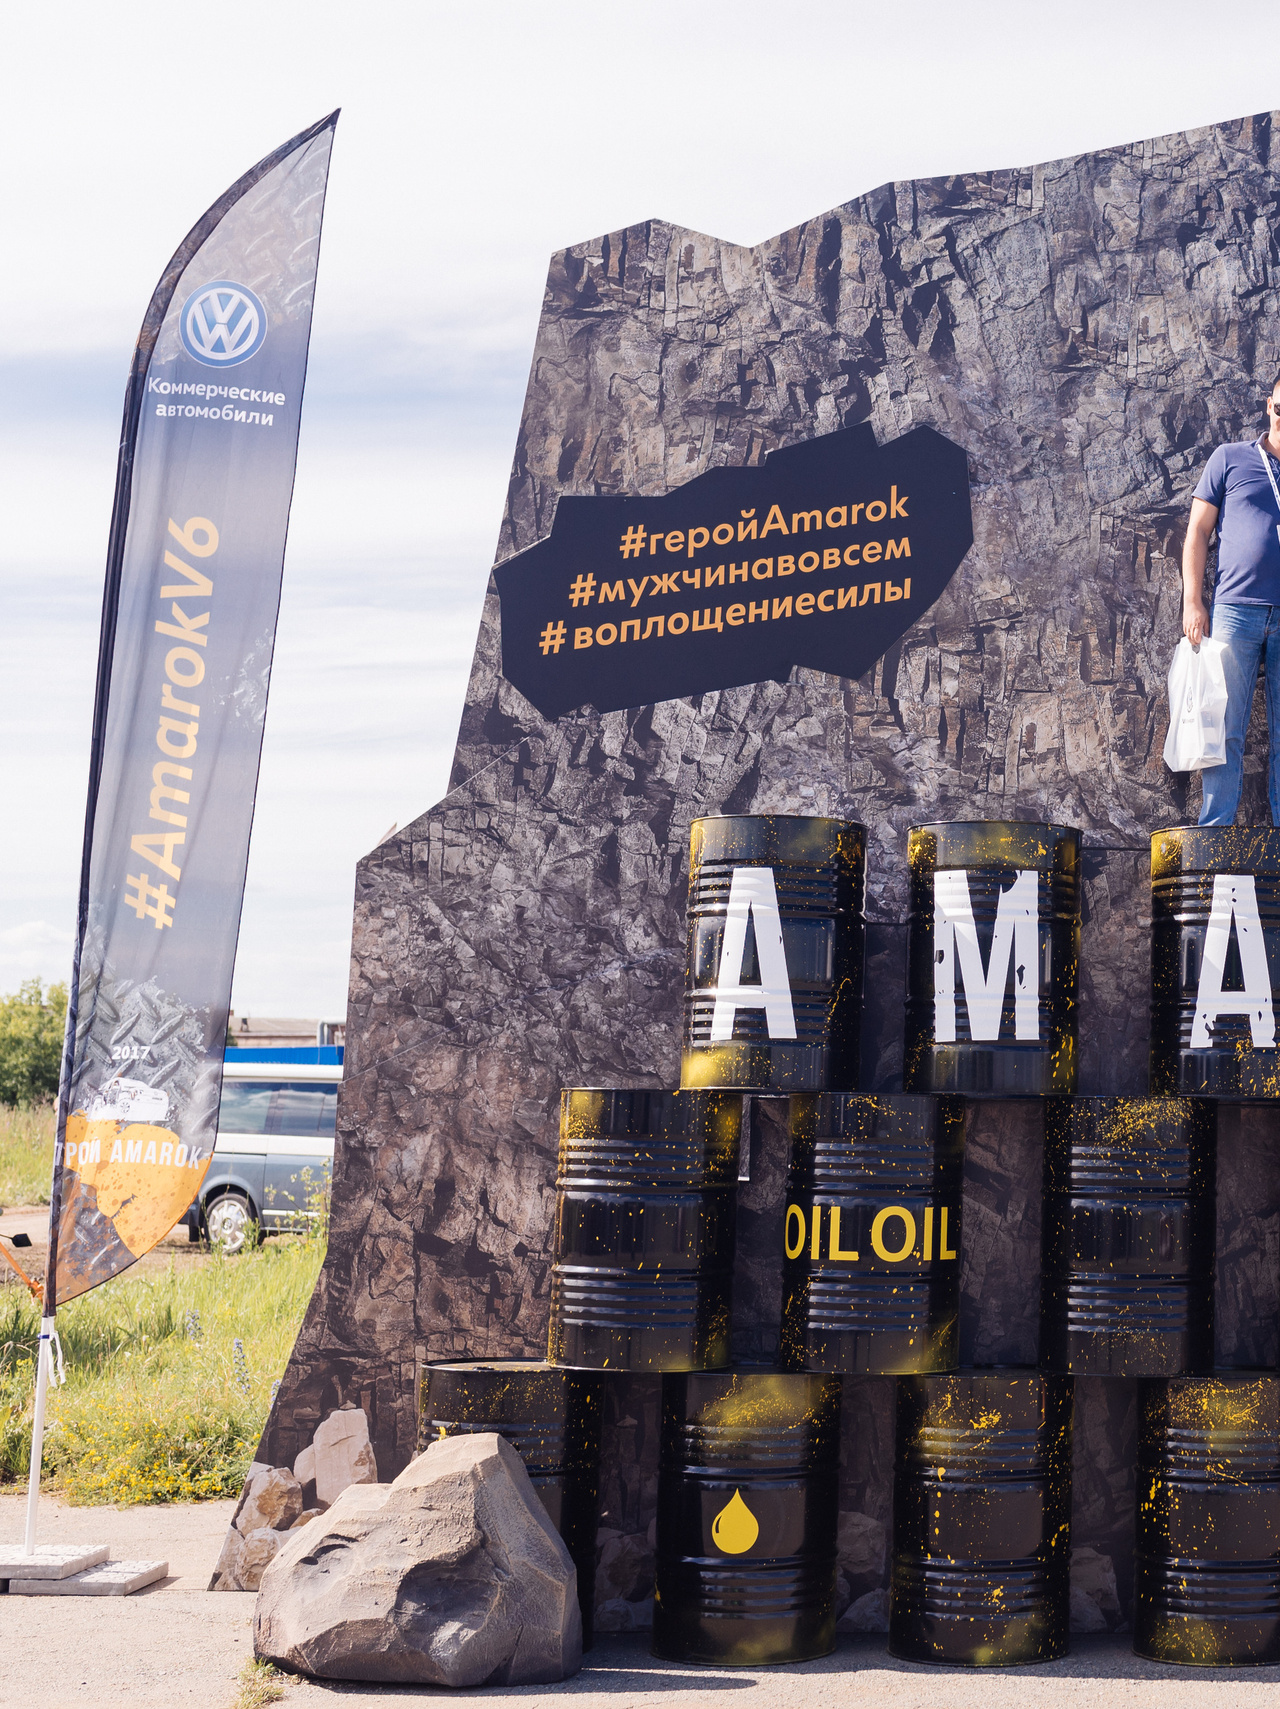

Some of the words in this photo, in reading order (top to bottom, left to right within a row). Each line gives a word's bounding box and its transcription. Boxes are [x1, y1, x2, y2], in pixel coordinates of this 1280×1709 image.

[148, 376, 286, 407] Коммерческие
[156, 400, 274, 428] автомобили
[620, 486, 909, 559] #геройAmarok
[569, 537, 911, 608] #мужчинавовсем
[539, 577, 911, 656] #воплощениесилы
[125, 516, 219, 930] #AmarokV6
[112, 1045, 151, 1060] 2017
[110, 1139, 203, 1170] AMAROK
[784, 1203, 860, 1261] OIL
[871, 1206, 957, 1262] OIL
